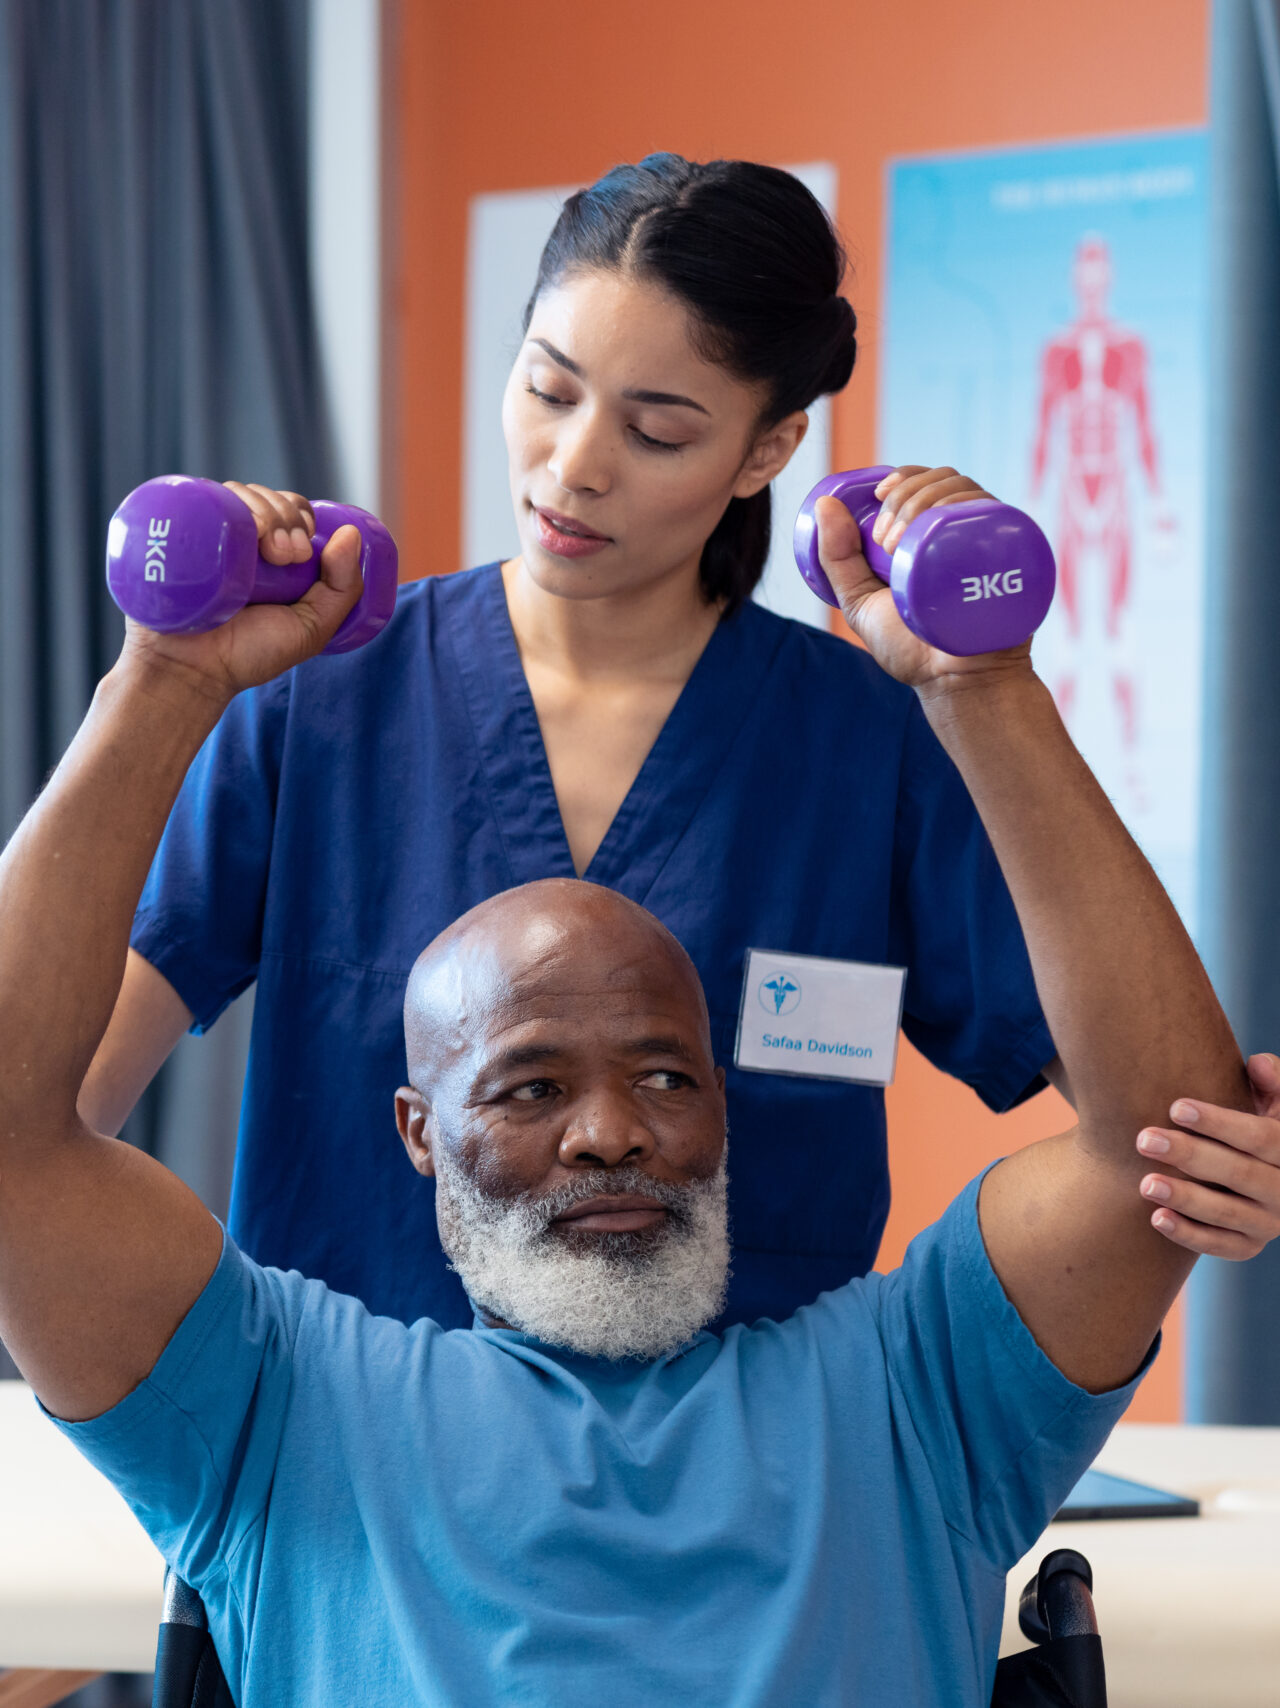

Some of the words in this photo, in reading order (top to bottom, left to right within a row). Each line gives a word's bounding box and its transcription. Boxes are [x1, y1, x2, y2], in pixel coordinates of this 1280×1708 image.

[144, 518, 171, 583] 3KG
[960, 568, 1023, 602] 3KG
[762, 1033, 802, 1051] Safaa
[807, 1039, 873, 1058] Davidson
